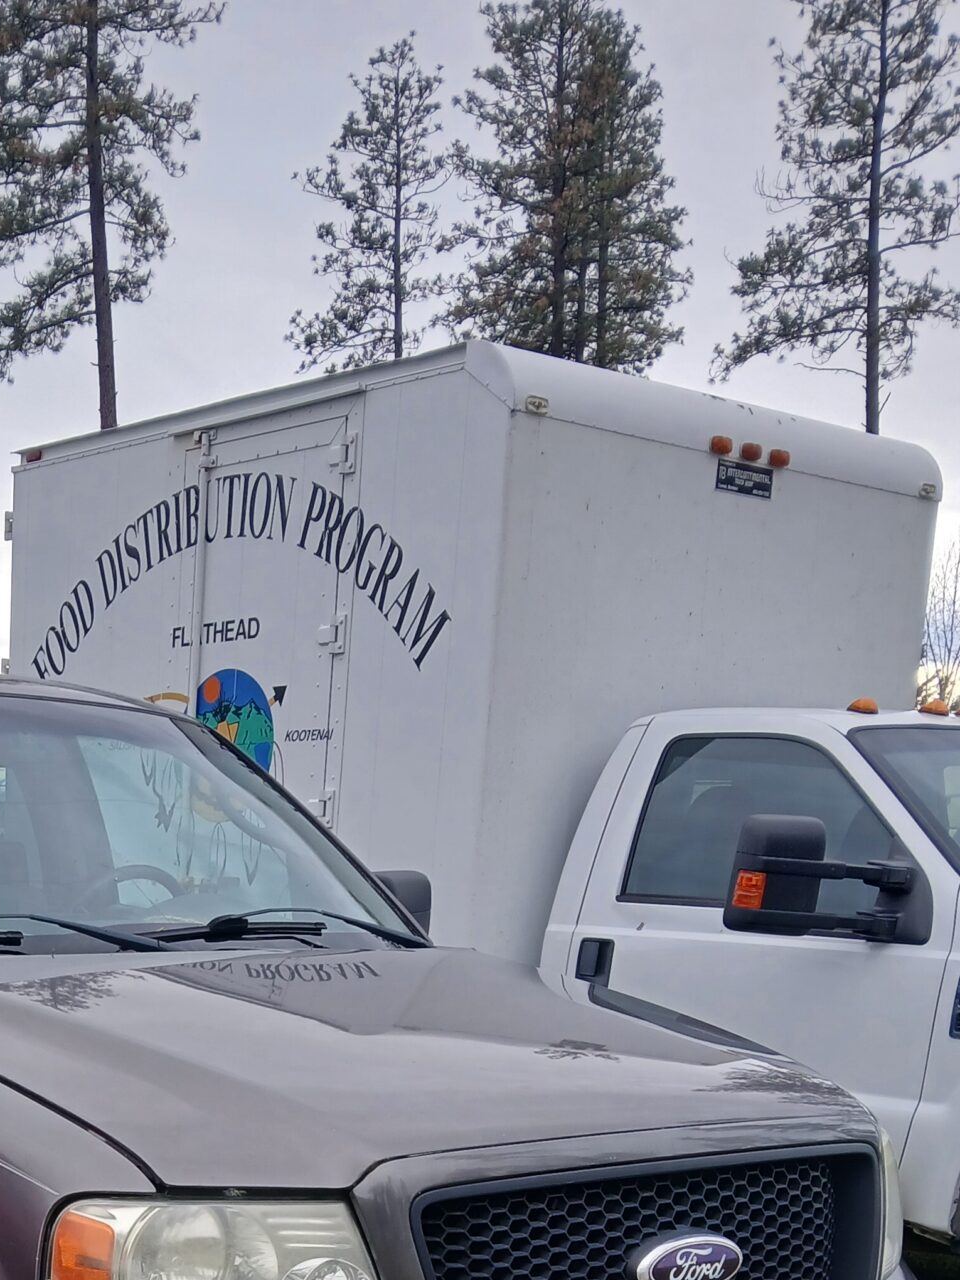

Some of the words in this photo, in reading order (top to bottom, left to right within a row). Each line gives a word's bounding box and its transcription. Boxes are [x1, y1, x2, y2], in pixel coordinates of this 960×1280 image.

[30, 579, 95, 680] FOOD
[95, 471, 298, 610] DISTRIBUTION
[296, 481, 453, 672] PROGRAM
[172, 617, 260, 648] FLTHEAD
[284, 728, 335, 742] KOOTENAI
